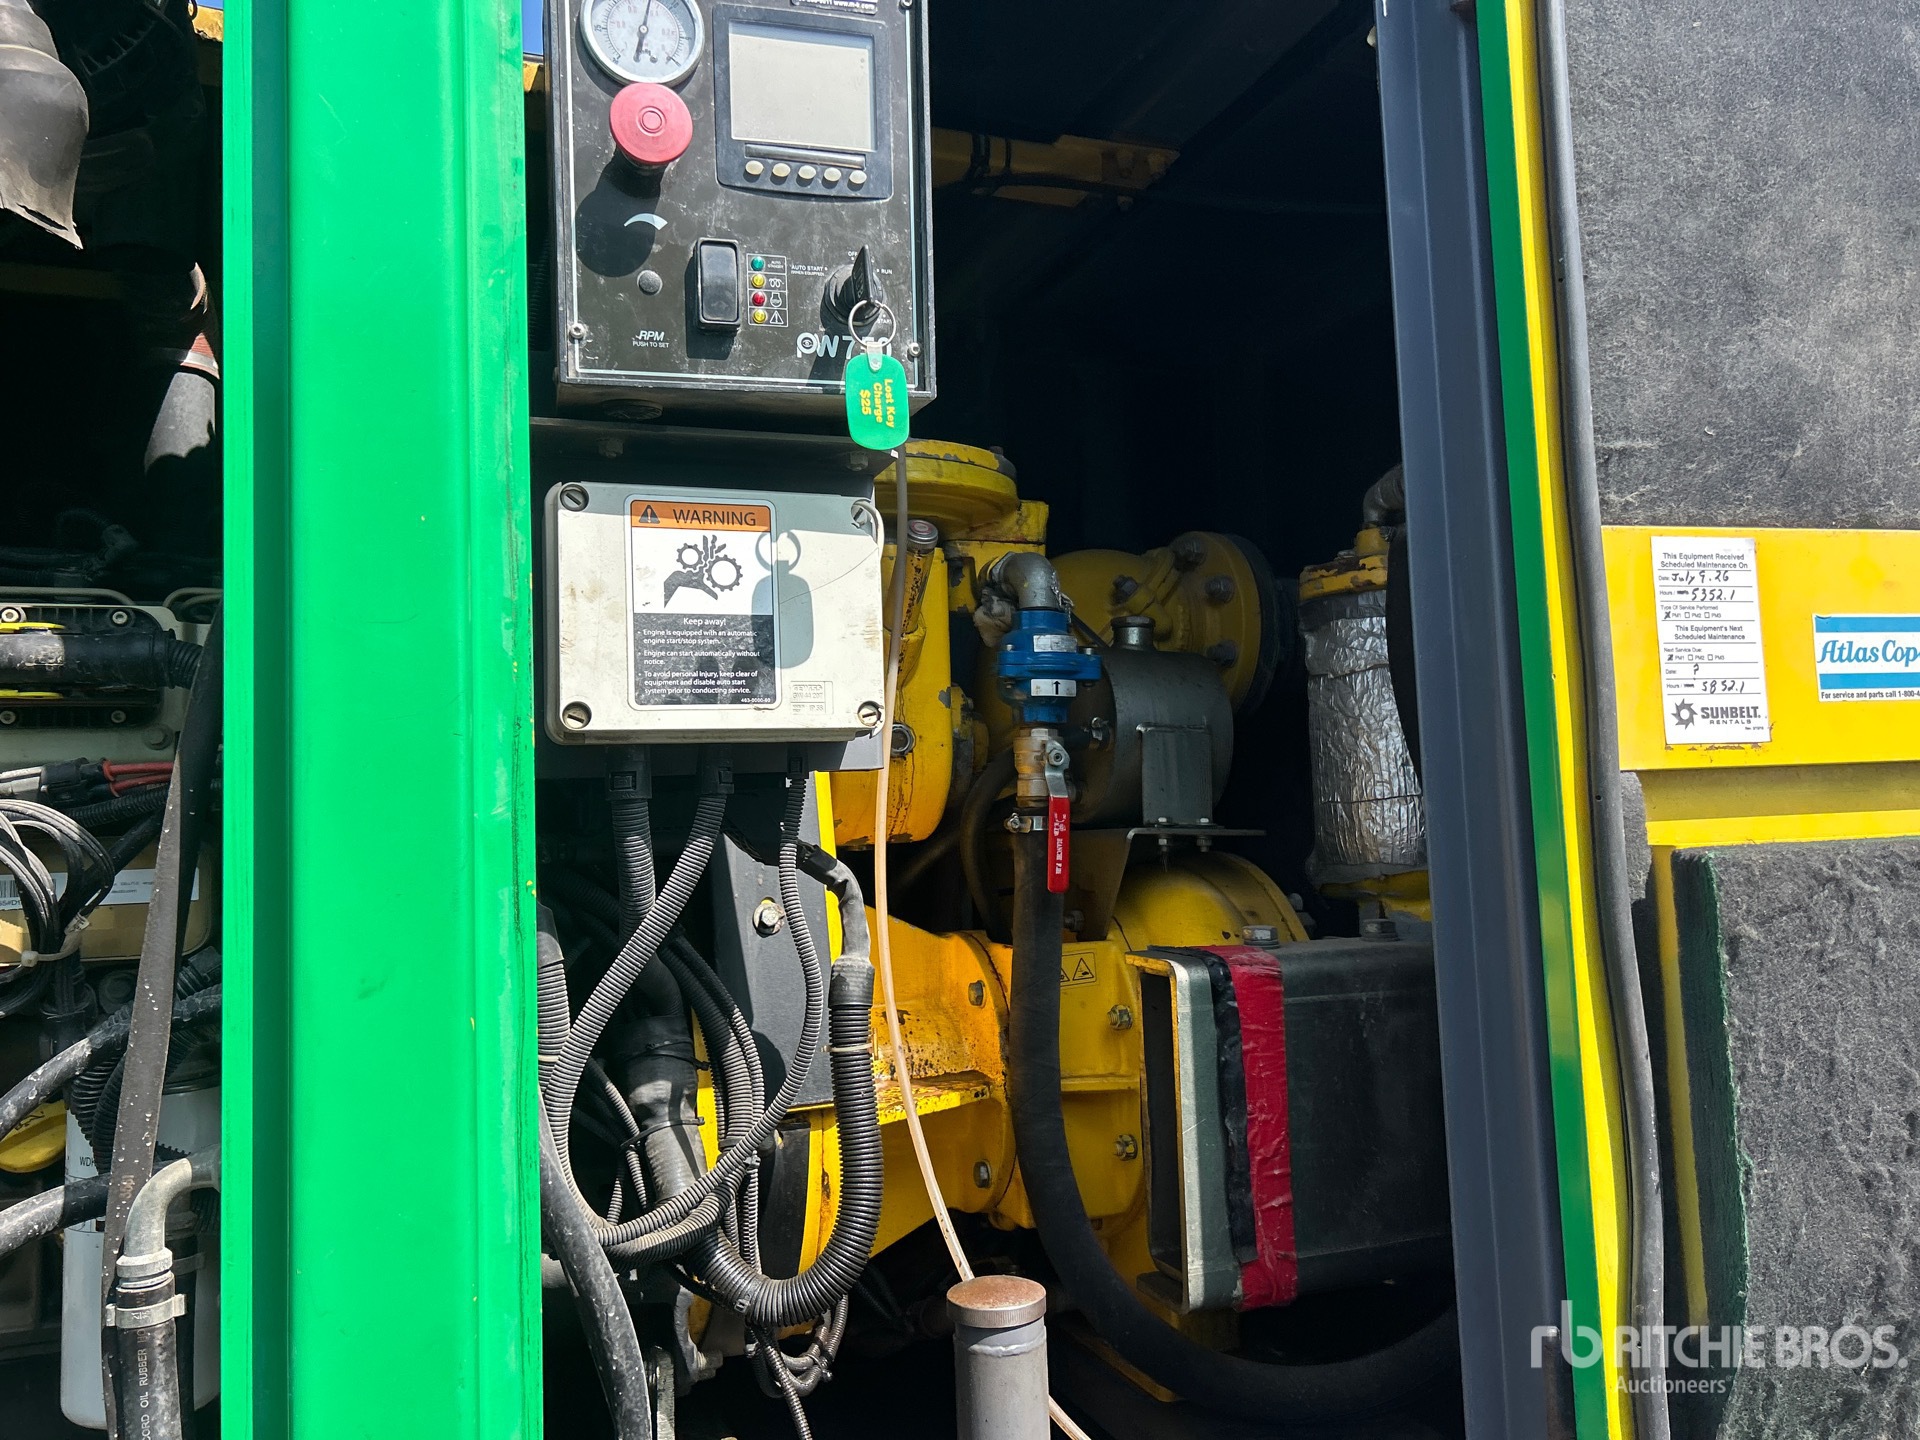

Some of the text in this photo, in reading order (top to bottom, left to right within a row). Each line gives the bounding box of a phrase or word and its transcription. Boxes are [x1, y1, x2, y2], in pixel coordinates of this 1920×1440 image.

[639, 330, 665, 342] RPM
[859, 389, 872, 416] $25
[873, 382, 883, 424] Charge
[884, 378, 896, 428] Lost Key
[672, 508, 757, 527] WARNING
[1662, 552, 1745, 562] This Equipment Received
[1660, 560, 1749, 569] Scheduled Maintenance On
[1671, 570, 1695, 585] July
[1691, 587, 1736, 602] 5352.1
[1660, 604, 1672, 612] Type
[683, 617, 727, 627] Keep away!
[643, 629, 665, 637] Engine
[672, 629, 703, 637] equipped
[703, 629, 718, 637] with
[727, 630, 758, 638] automatic
[1675, 624, 1689, 632] This
[1690, 624, 1728, 633] Equipment's
[643, 637, 721, 646] engine start/stop system.
[1674, 633, 1707, 641] Scheduled
[643, 650, 666, 658] Engine
[694, 650, 736, 659] automatically
[1816, 639, 1920, 668] Atlas Cop
[671, 670, 699, 679] personal
[699, 670, 719, 679] injury,
[719, 670, 735, 679] keep
[644, 679, 680, 687] equipment
[693, 678, 716, 686] disable
[644, 688, 667, 696] system
[667, 687, 684, 695] prior
[691, 687, 728, 695] conducting
[1821, 691, 1831, 699] For
[1832, 690, 1855, 699] service
[1855, 690, 1867, 699] and
[1868, 690, 1885, 700] parts
[1885, 690, 1897, 698] call
[137, 1348, 149, 1387] RUBBER
[139, 1391, 149, 1408] OIL
